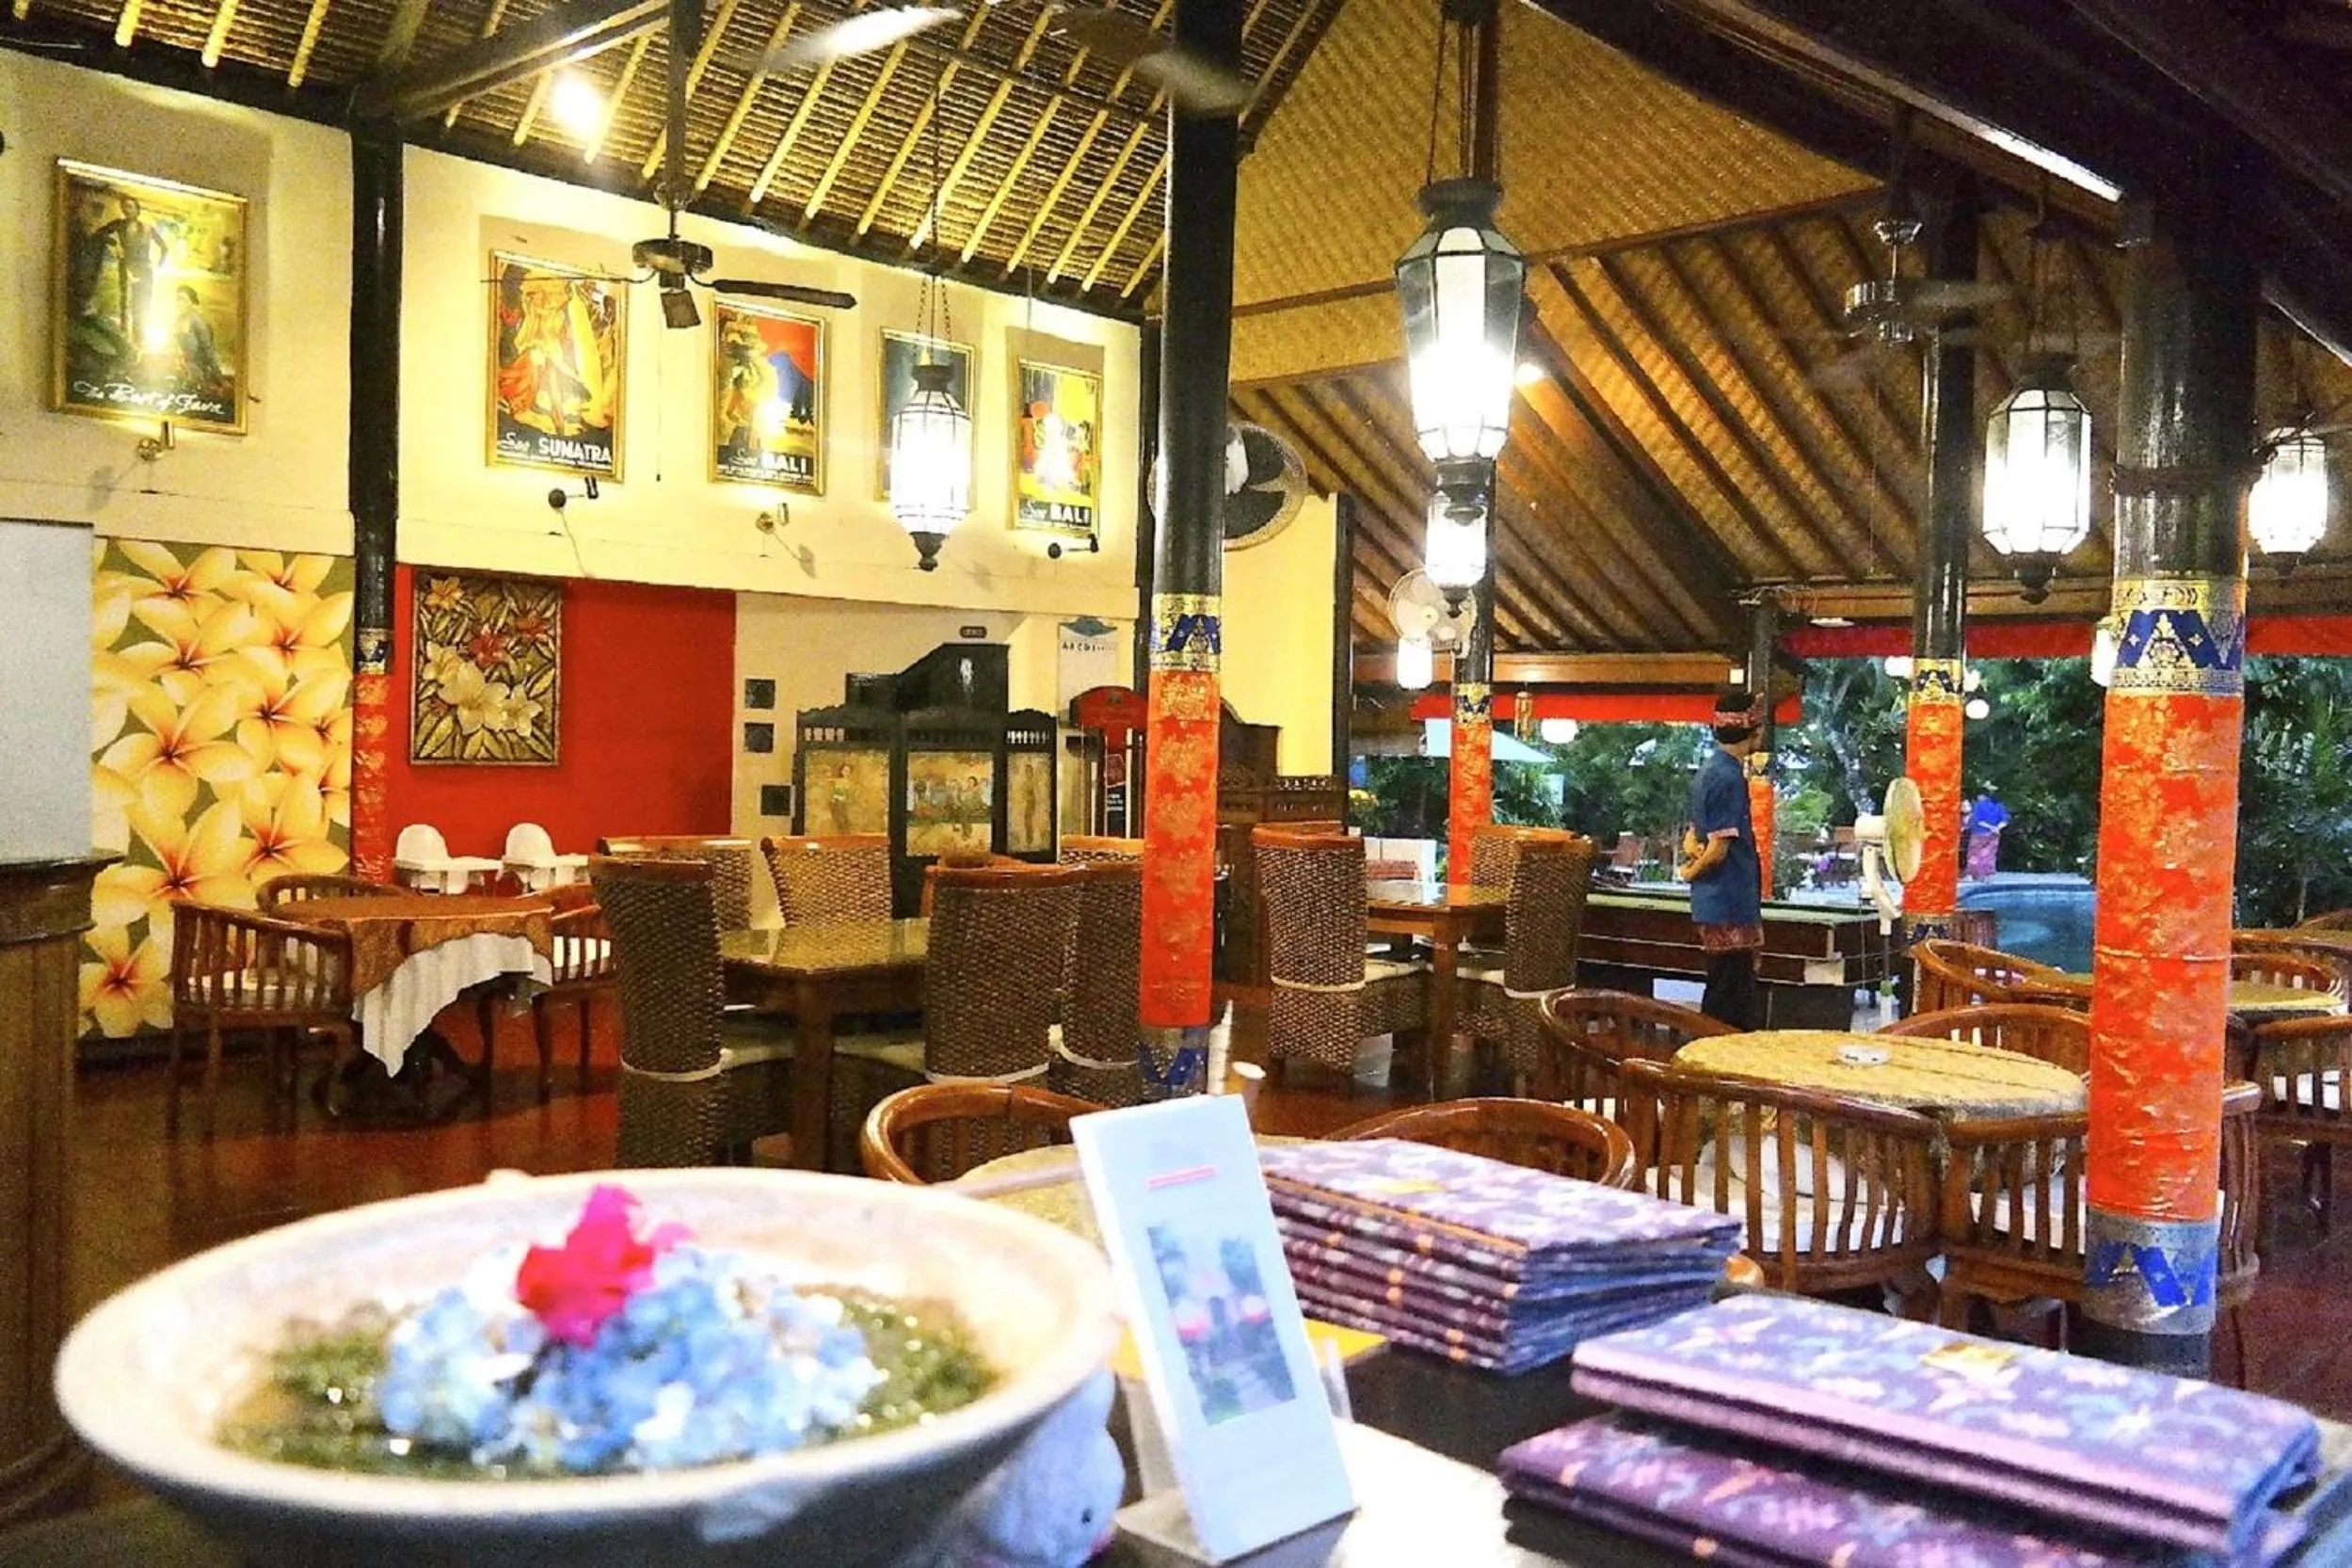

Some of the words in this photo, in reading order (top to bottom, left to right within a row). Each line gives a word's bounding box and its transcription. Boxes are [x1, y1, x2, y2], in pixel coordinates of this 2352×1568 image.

[537, 436, 612, 463] SUMATRA
[760, 451, 808, 474] BALI
[1049, 503, 1090, 524] BALI
